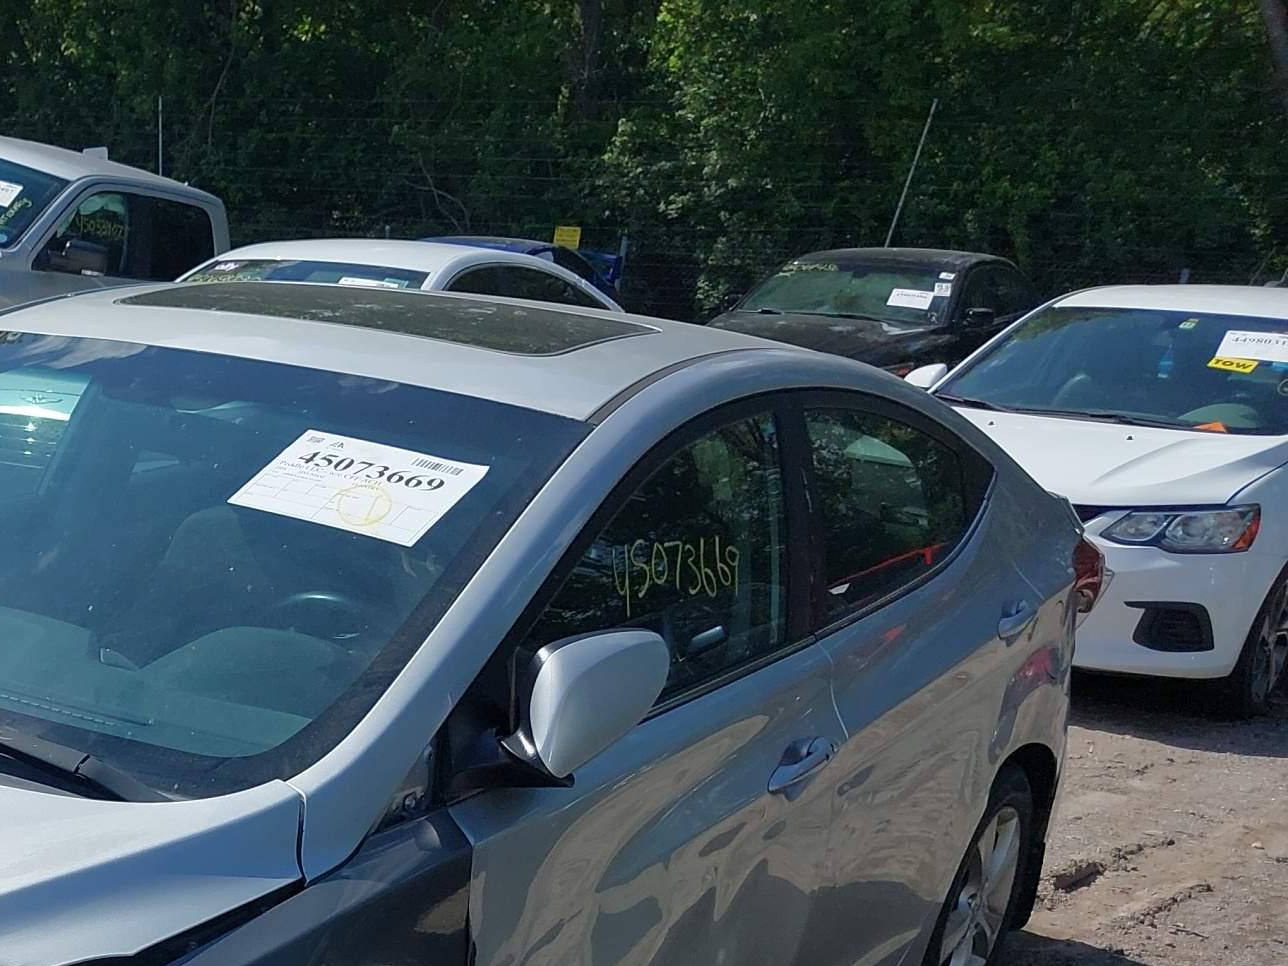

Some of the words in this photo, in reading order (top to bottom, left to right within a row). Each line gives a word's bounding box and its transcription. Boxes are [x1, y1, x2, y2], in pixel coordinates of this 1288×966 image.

[1214, 359, 1253, 370] TOW
[298, 450, 445, 492] 45073669
[612, 535, 740, 618] 45073669
